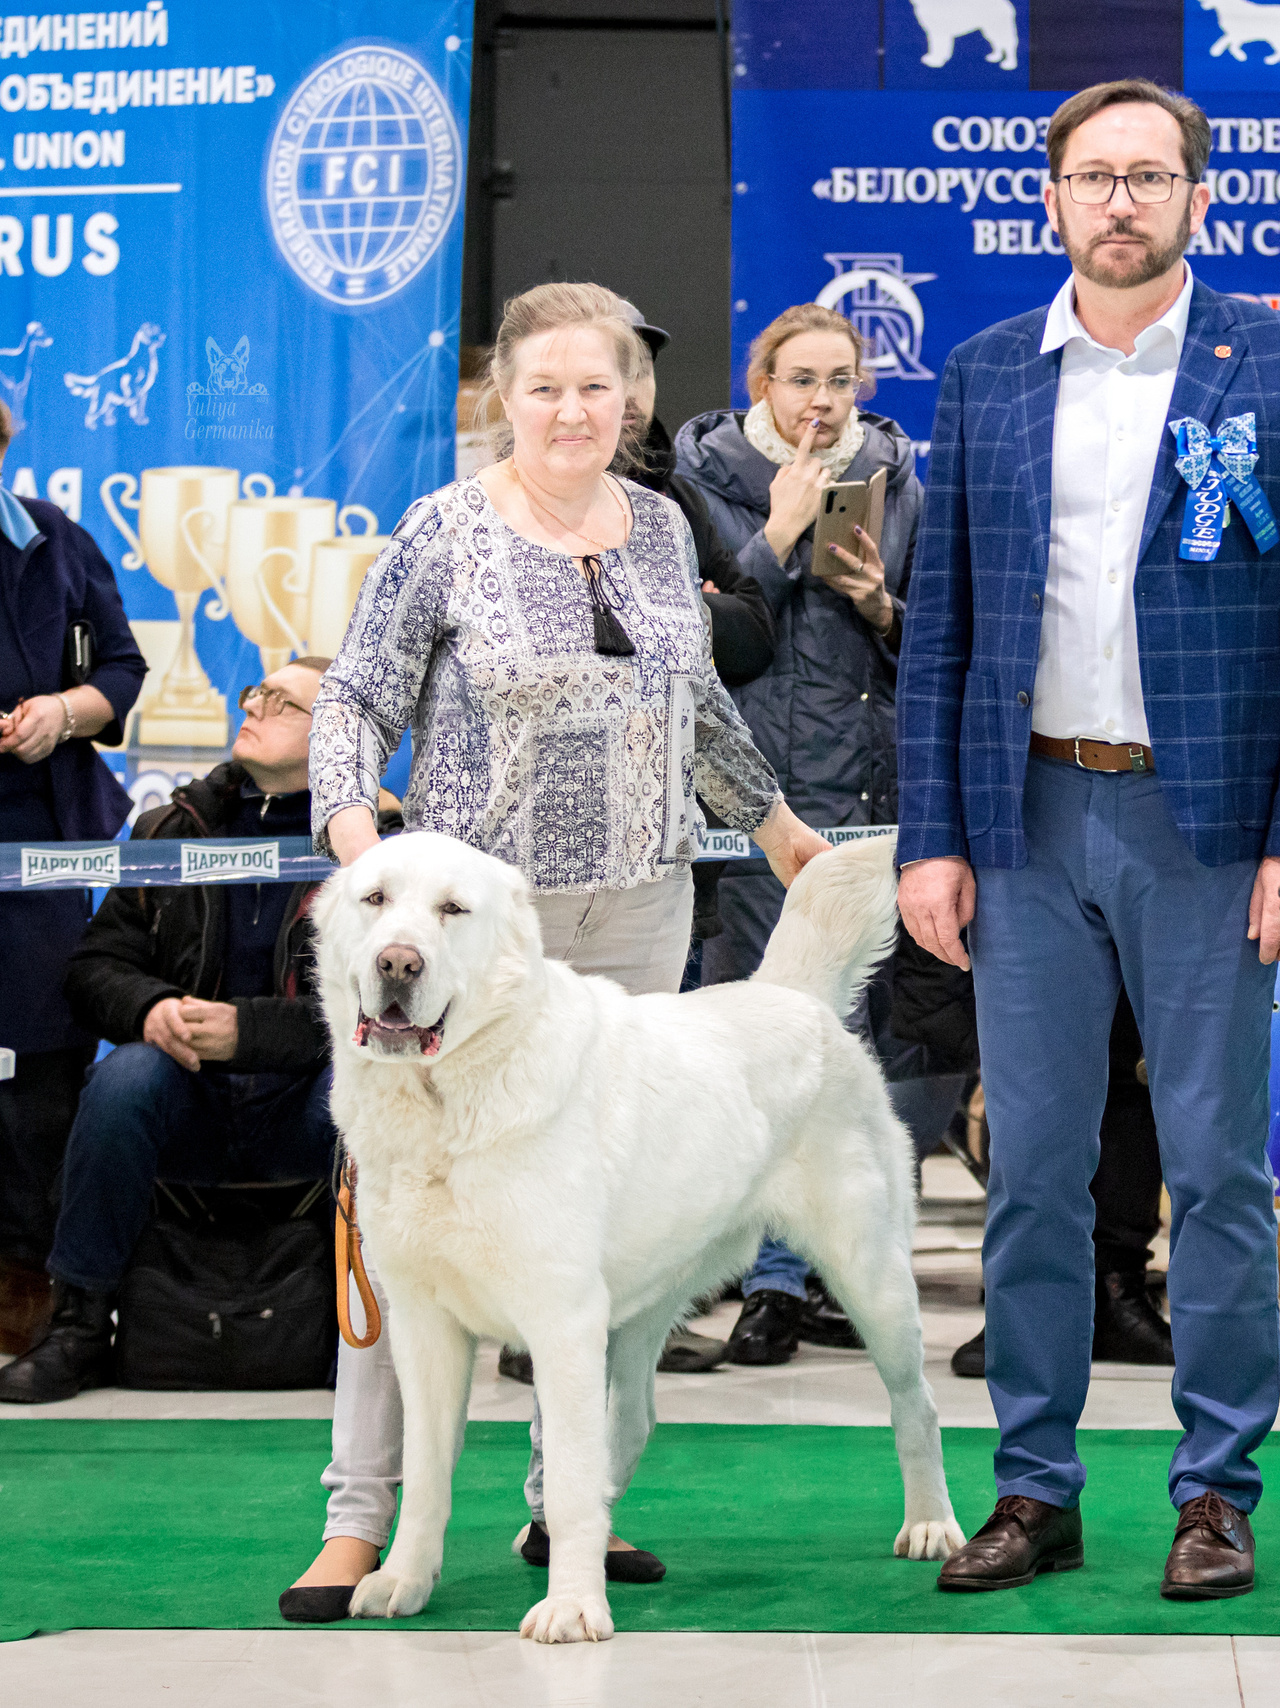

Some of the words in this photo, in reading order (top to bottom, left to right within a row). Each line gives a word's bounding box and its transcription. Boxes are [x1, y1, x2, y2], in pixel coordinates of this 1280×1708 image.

[0, 66, 276, 115] ОБЪЕДИНЕНИЕ»
[286, 54, 418, 136] CYNOLOGIQUE
[13, 129, 126, 171] UNION
[325, 153, 400, 197] FCI
[383, 81, 455, 287] INTERNATIONALE
[812, 166, 1050, 213] «БЕЛОРУСС
[273, 138, 335, 289] FEDERATION
[27, 854, 79, 876] HAPPY
[81, 853, 114, 874] DOG
[187, 850, 238, 872] HAPPY
[241, 849, 273, 870] DOG
[713, 832, 744, 853] DOG
